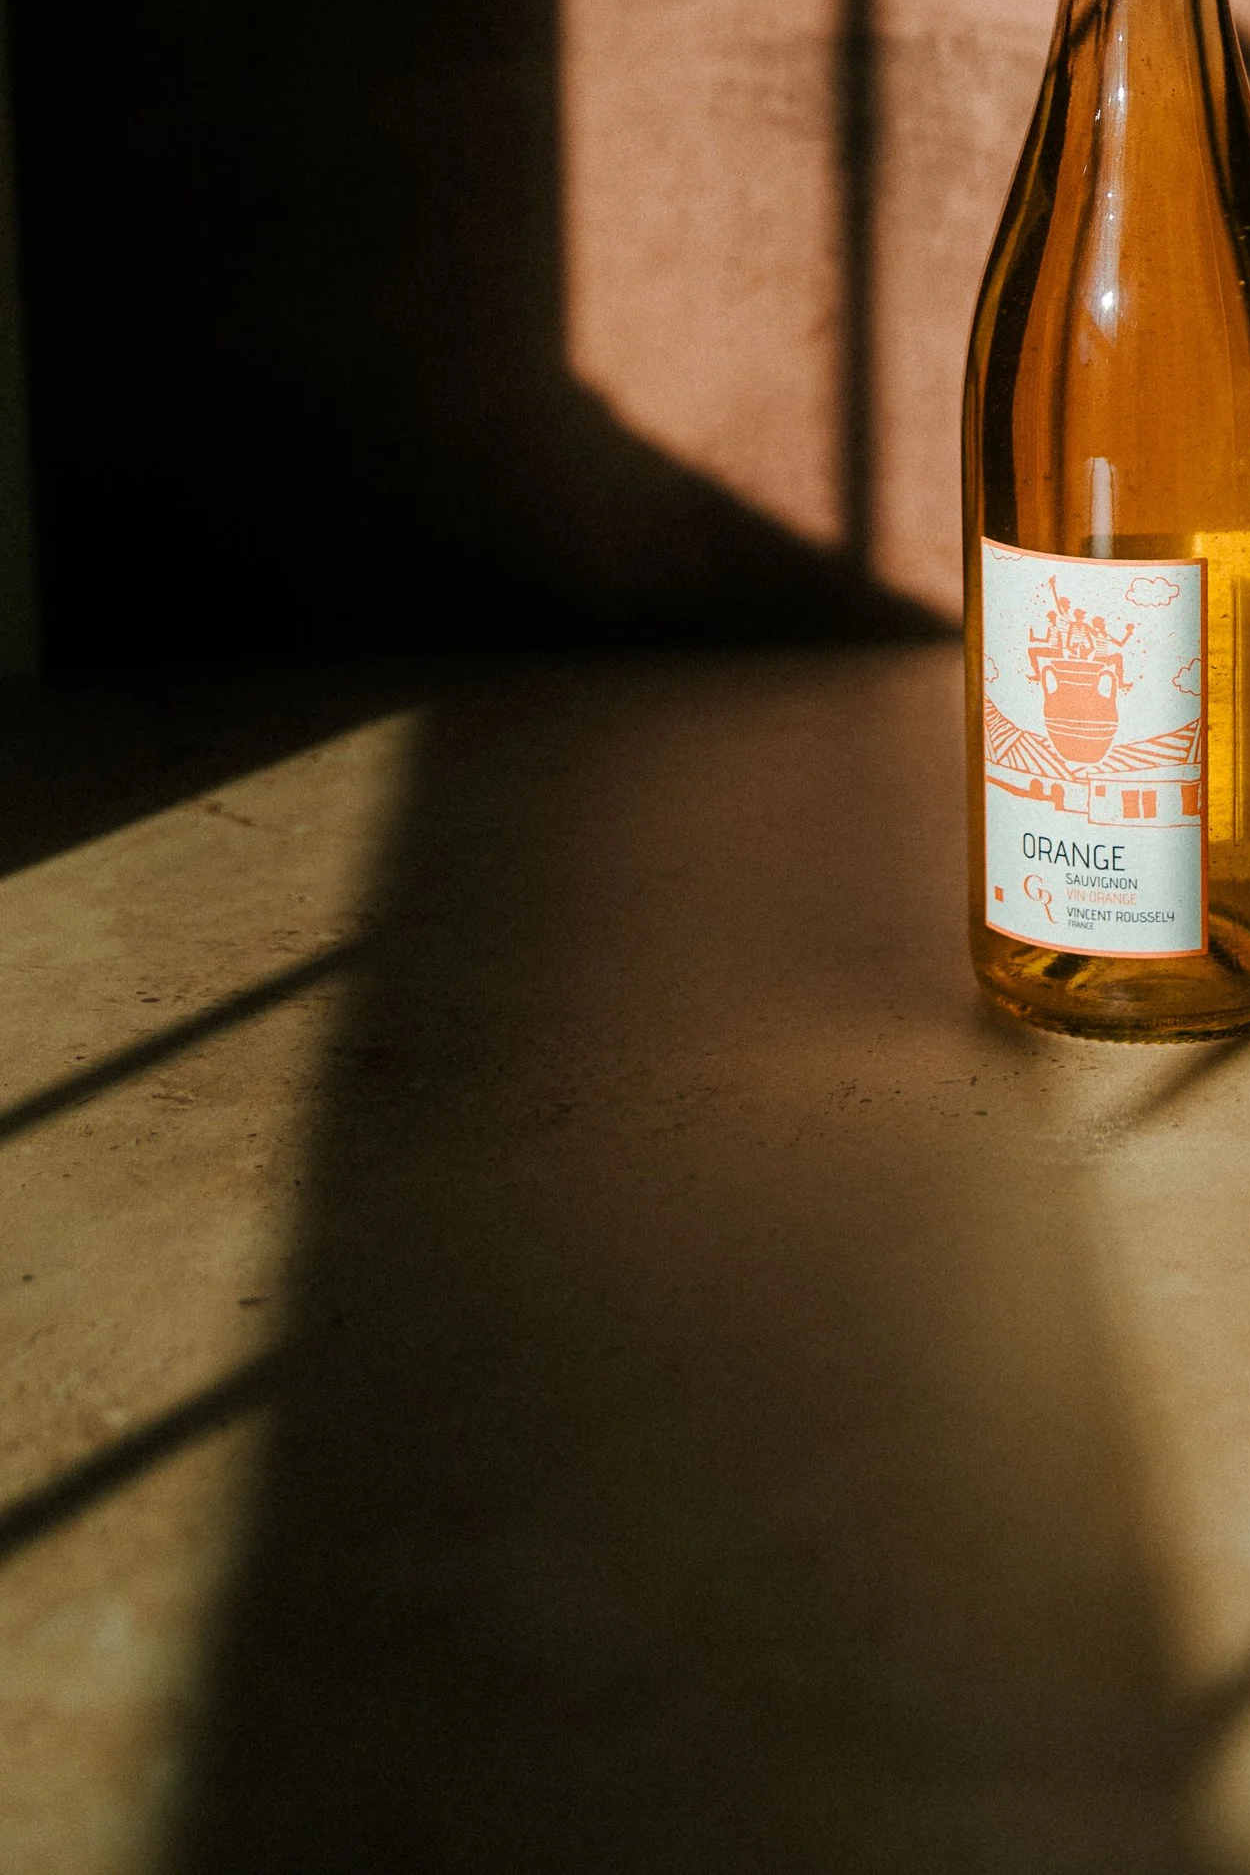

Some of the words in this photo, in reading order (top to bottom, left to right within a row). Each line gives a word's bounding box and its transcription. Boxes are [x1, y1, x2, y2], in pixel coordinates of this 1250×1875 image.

[1023, 832, 1125, 871] ORANGE
[1065, 873, 1138, 890] SAUVIGNON
[1066, 888, 1086, 902] VIN
[1089, 890, 1137, 906] ORANGE
[1066, 907, 1112, 922] VINCENT
[1115, 910, 1175, 923] ROUSSELY
[1068, 920, 1094, 930] FRANCE
